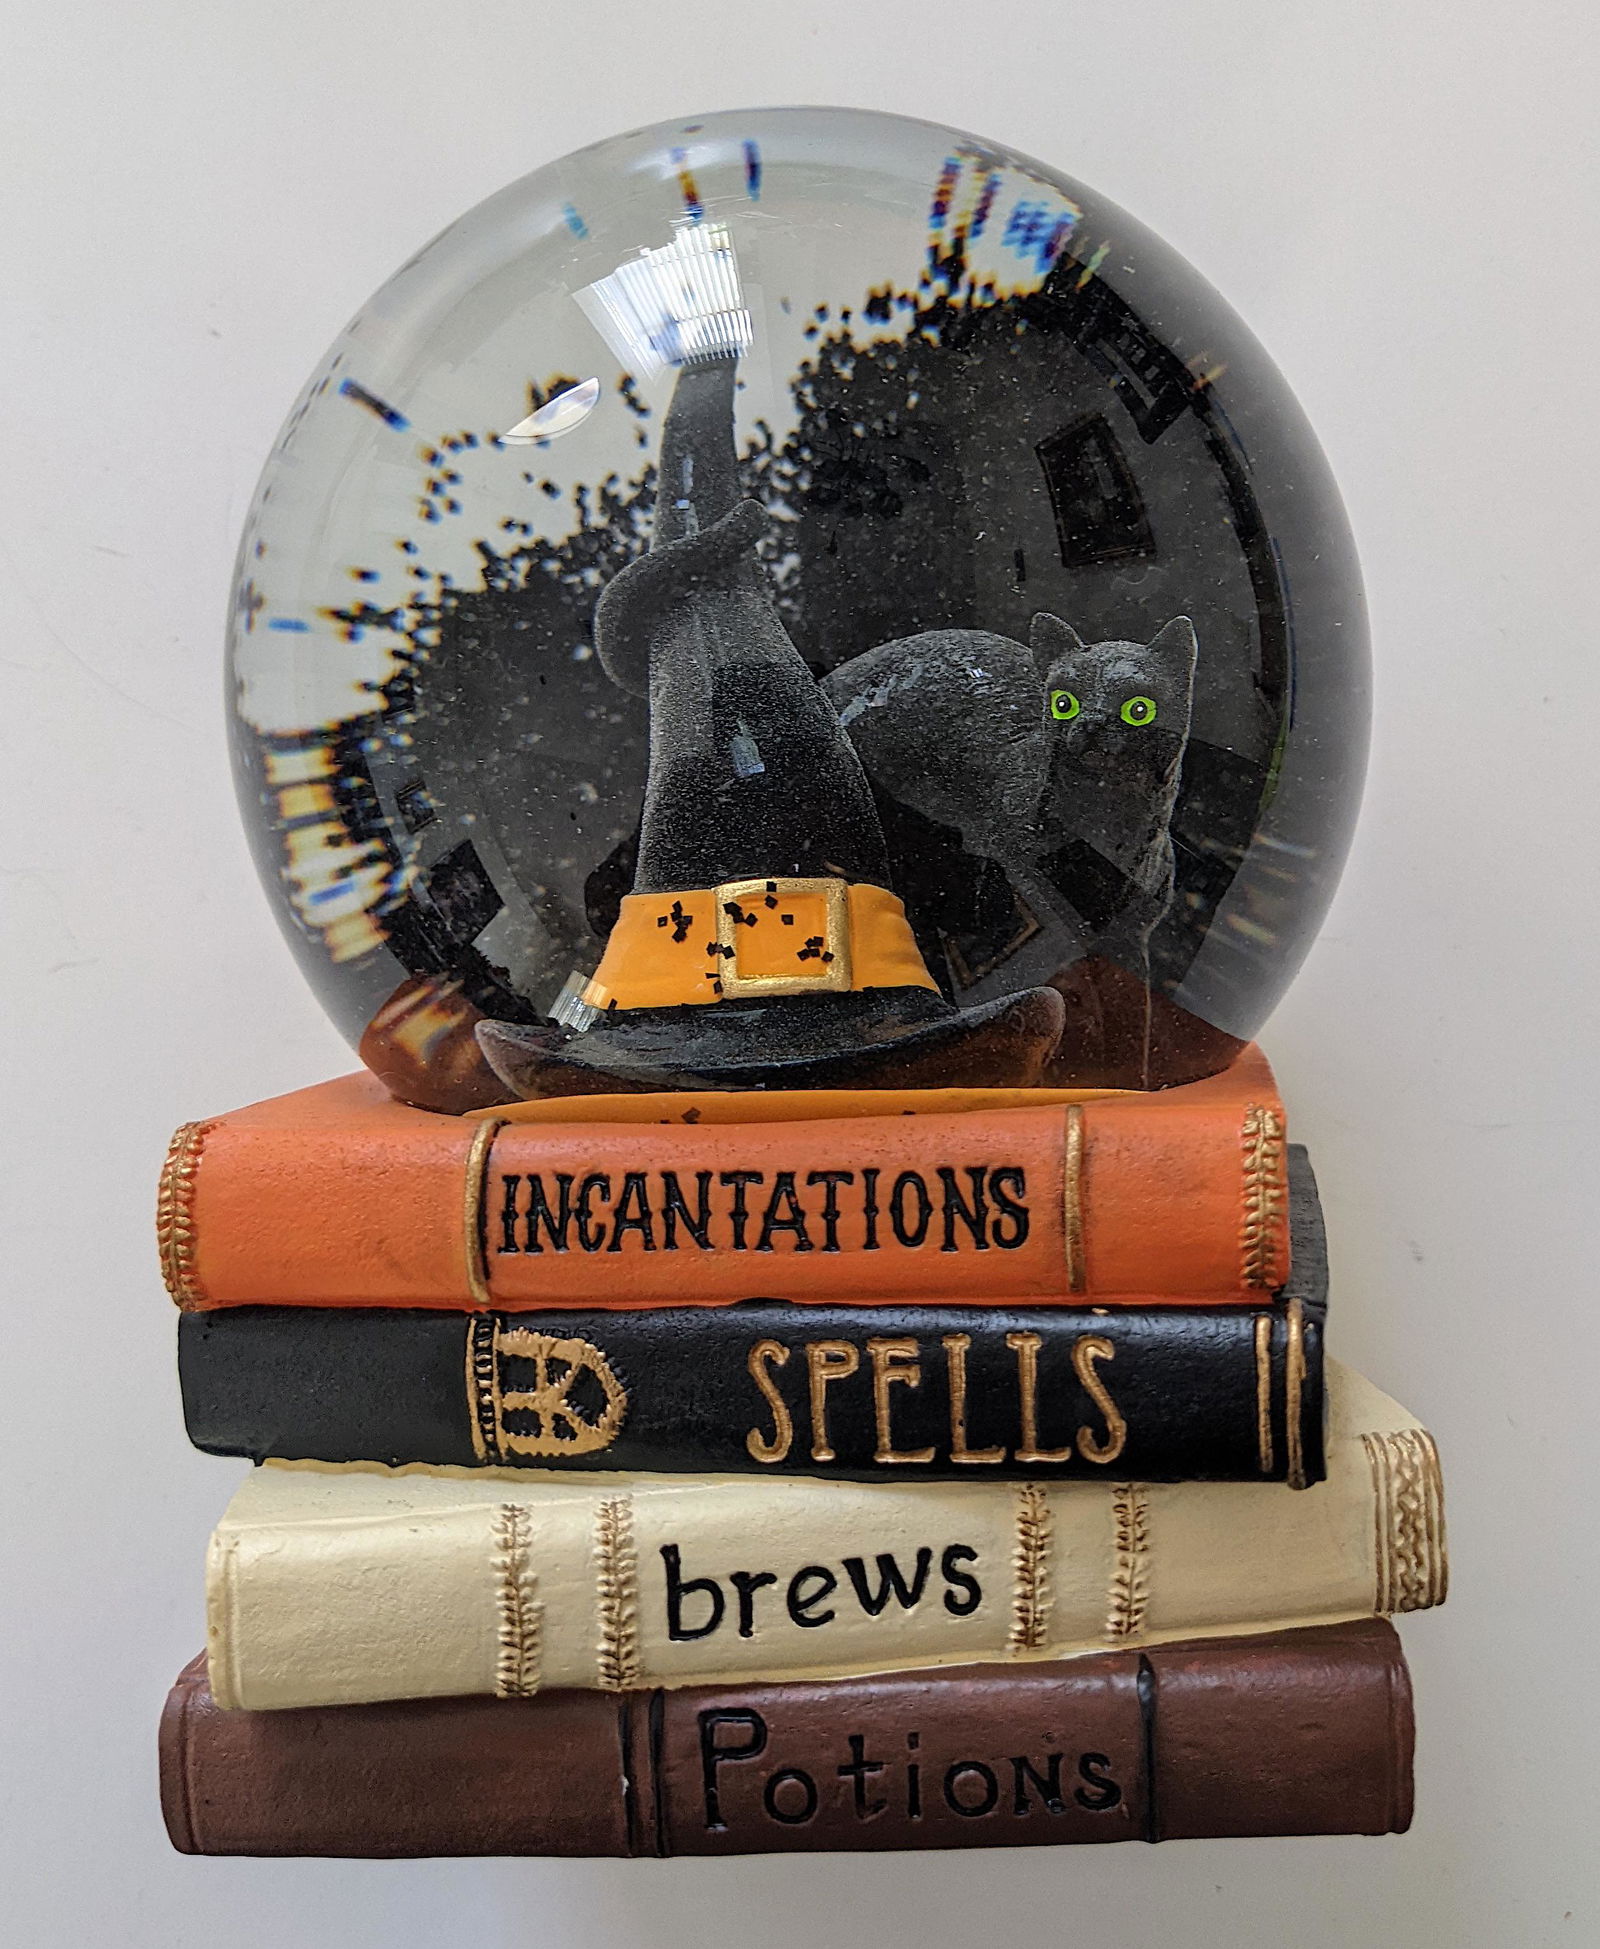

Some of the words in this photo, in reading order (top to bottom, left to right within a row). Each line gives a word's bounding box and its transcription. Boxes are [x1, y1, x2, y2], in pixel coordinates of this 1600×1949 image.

[497, 1165, 1030, 1254] INCANTATIONS
[746, 1329, 1127, 1464] SPELLS
[659, 1543, 984, 1641] brews
